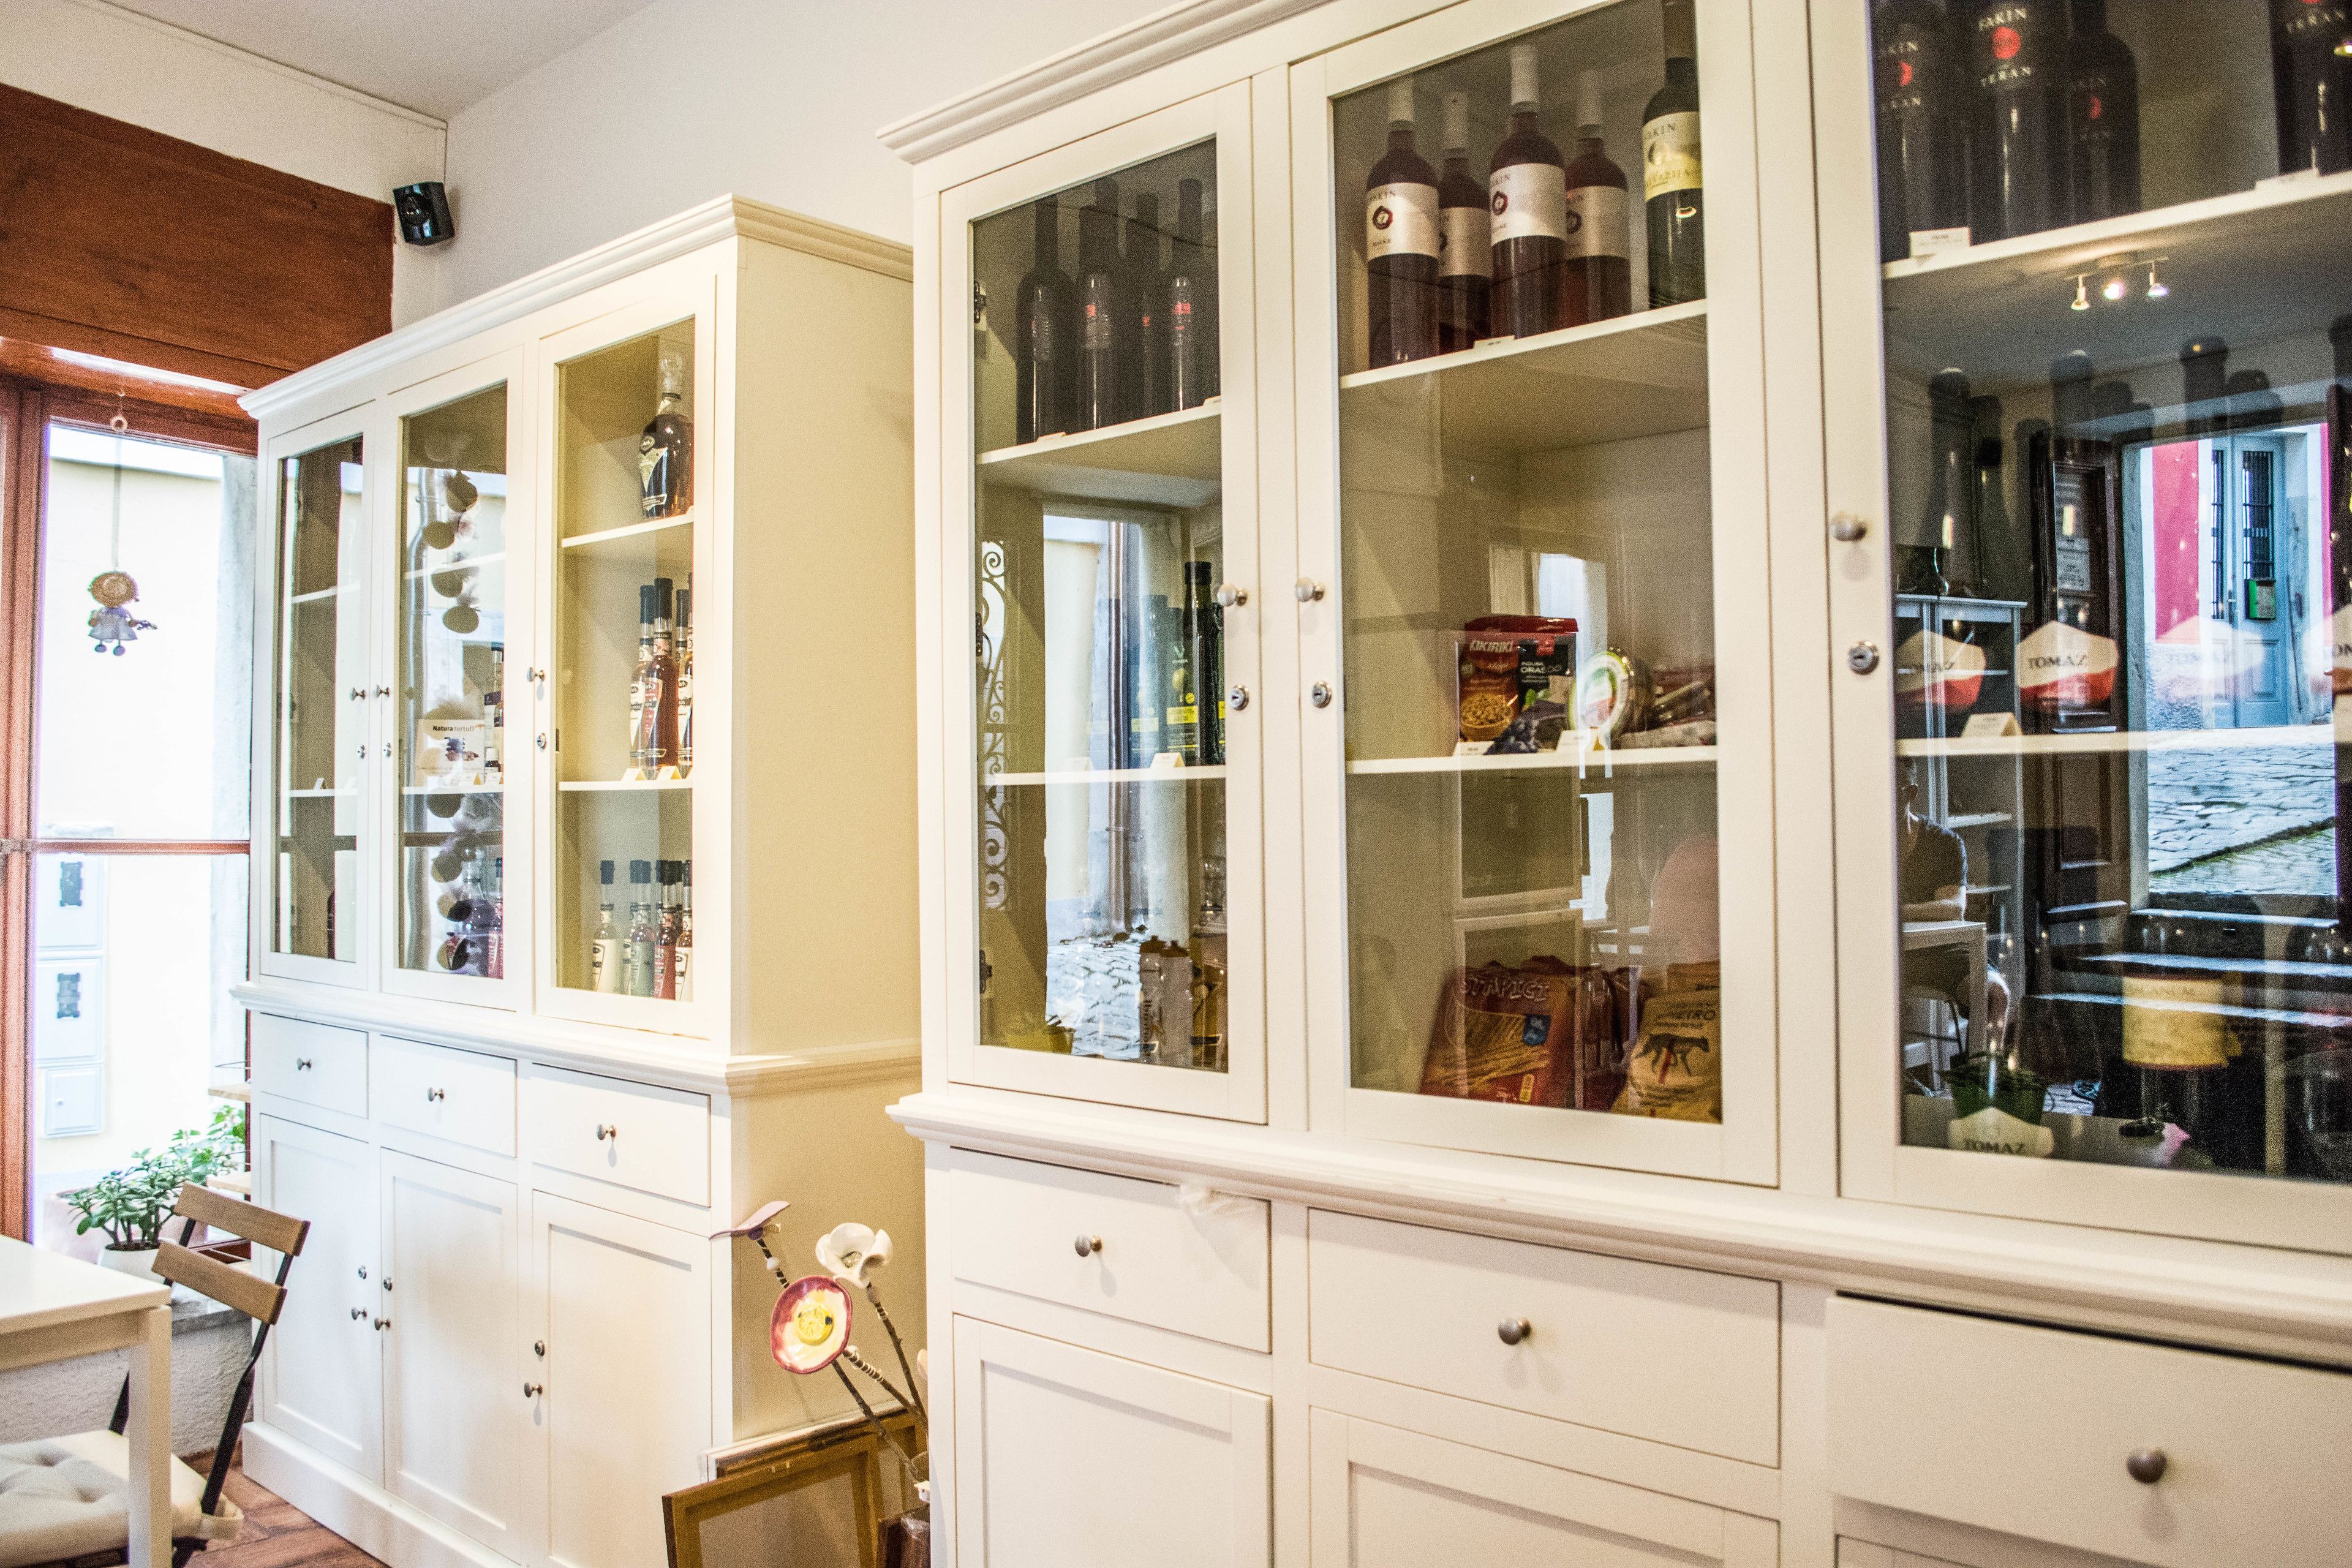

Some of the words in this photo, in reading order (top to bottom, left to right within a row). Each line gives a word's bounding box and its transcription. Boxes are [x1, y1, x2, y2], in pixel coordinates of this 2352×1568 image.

[1979, 9, 2027, 31] FAKIN
[2286, 9, 2346, 34] TERAN
[1981, 67, 2032, 88] TERAN
[2027, 654, 2087, 669] TOMAZ
[1963, 1138, 2026, 1155] TOMAZ
